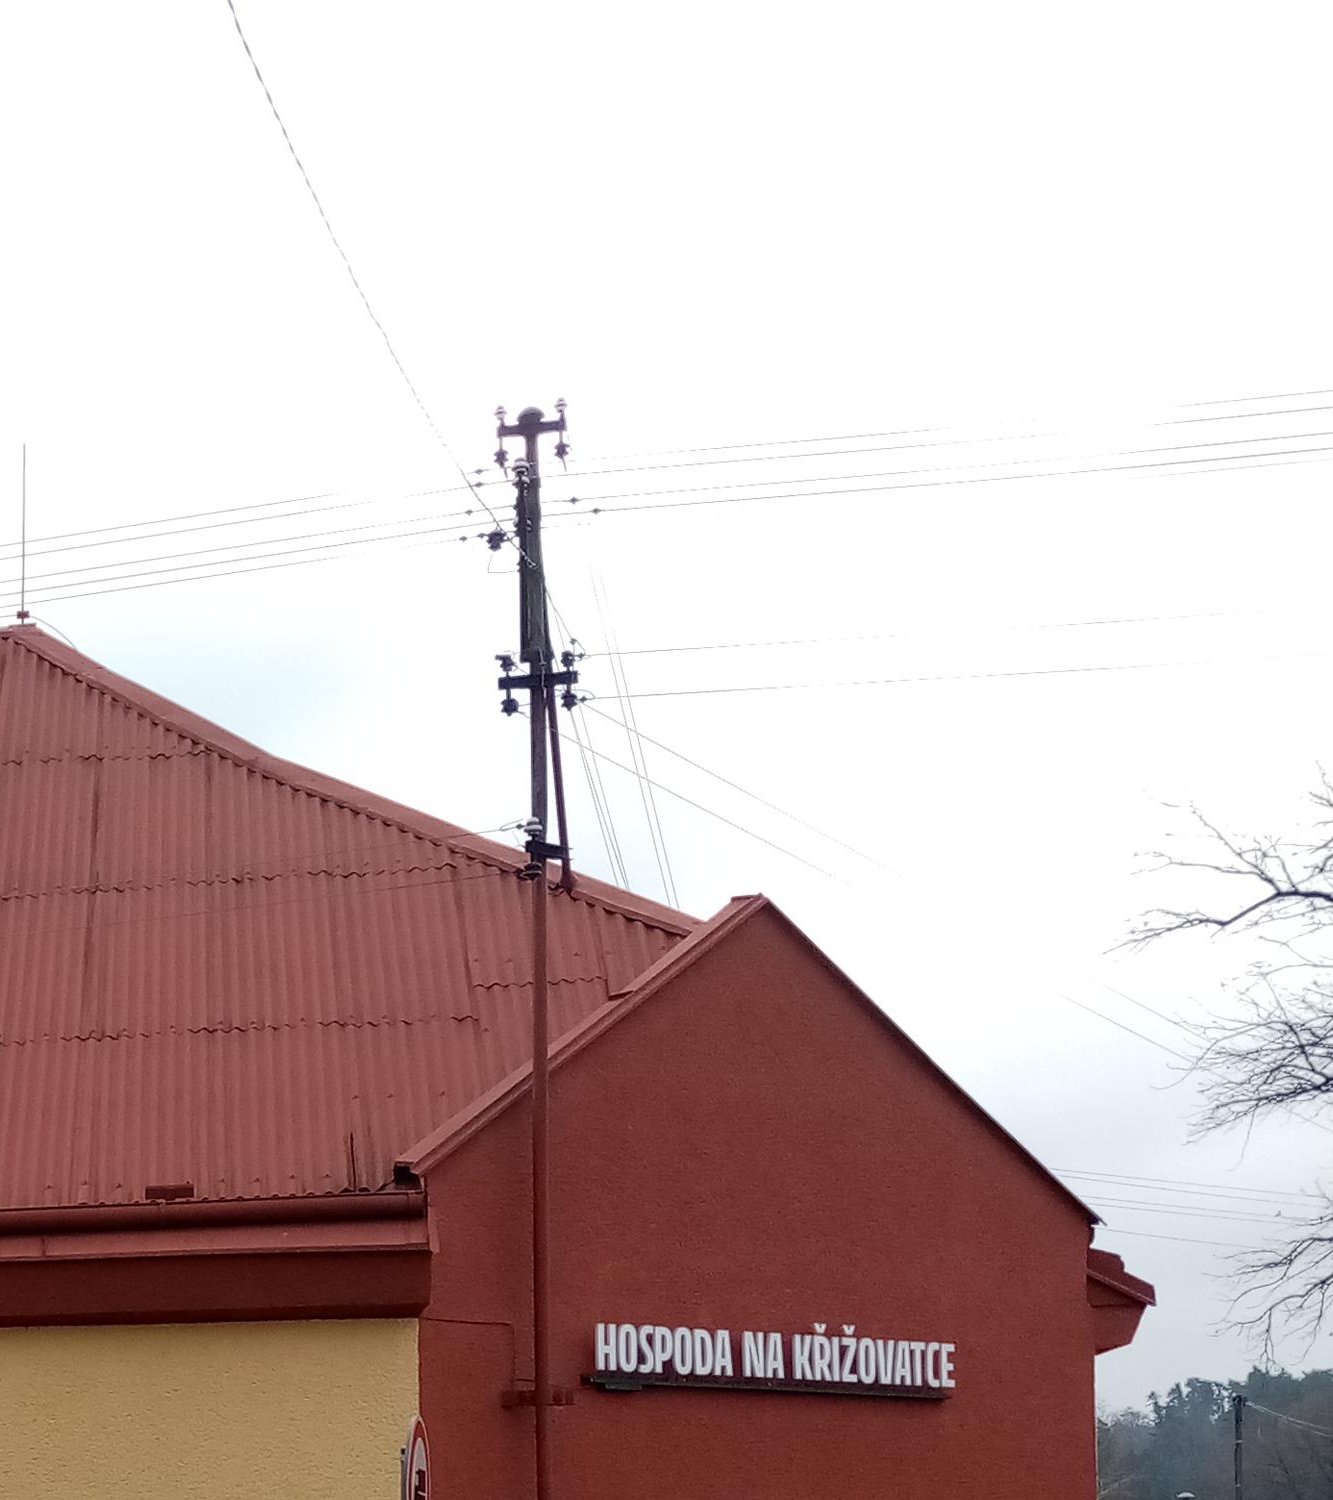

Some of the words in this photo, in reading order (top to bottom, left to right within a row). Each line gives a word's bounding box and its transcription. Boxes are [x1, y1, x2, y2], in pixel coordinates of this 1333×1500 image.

[594, 1322, 733, 1376] HOSPODA
[741, 1330, 785, 1379] NA
[792, 1322, 957, 1388] KŘIŽOVATCE
